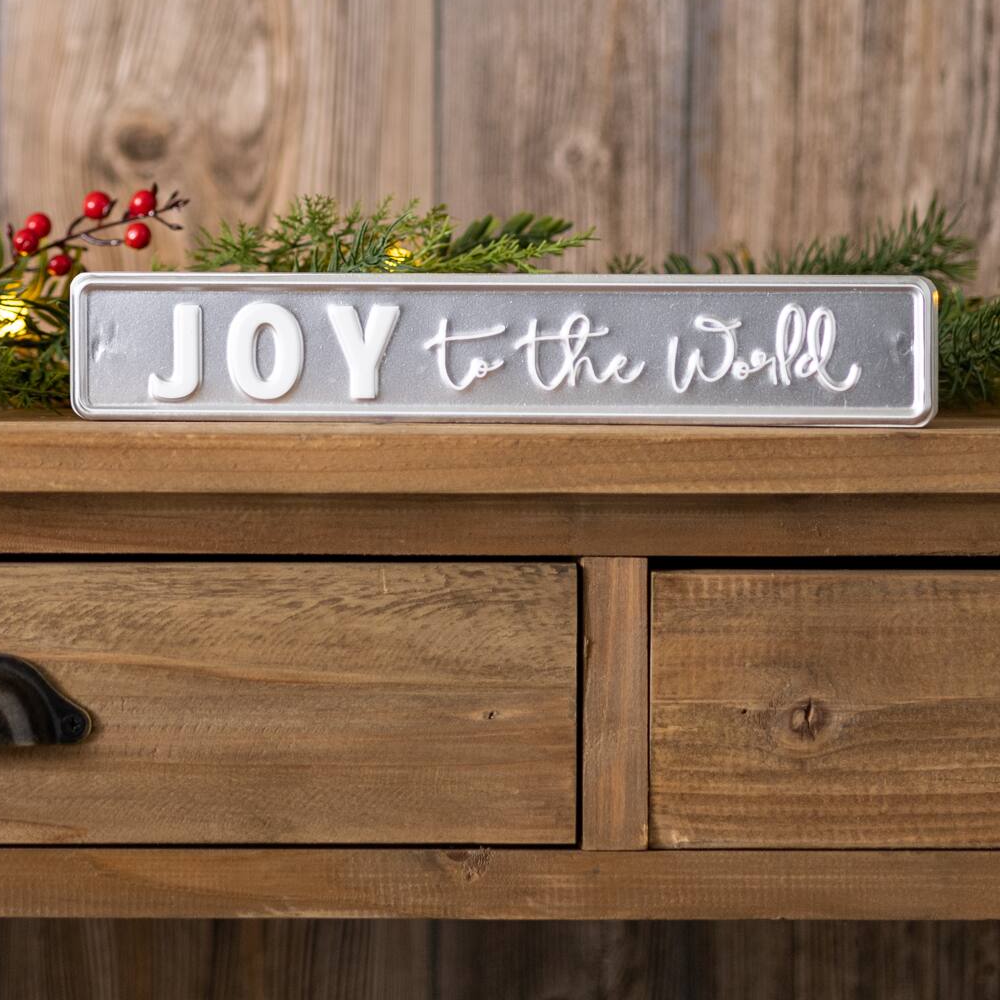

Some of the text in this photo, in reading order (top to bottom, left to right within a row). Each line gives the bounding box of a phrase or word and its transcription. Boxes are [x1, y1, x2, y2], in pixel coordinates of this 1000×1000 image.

[147, 301, 863, 400] JOY to the World
